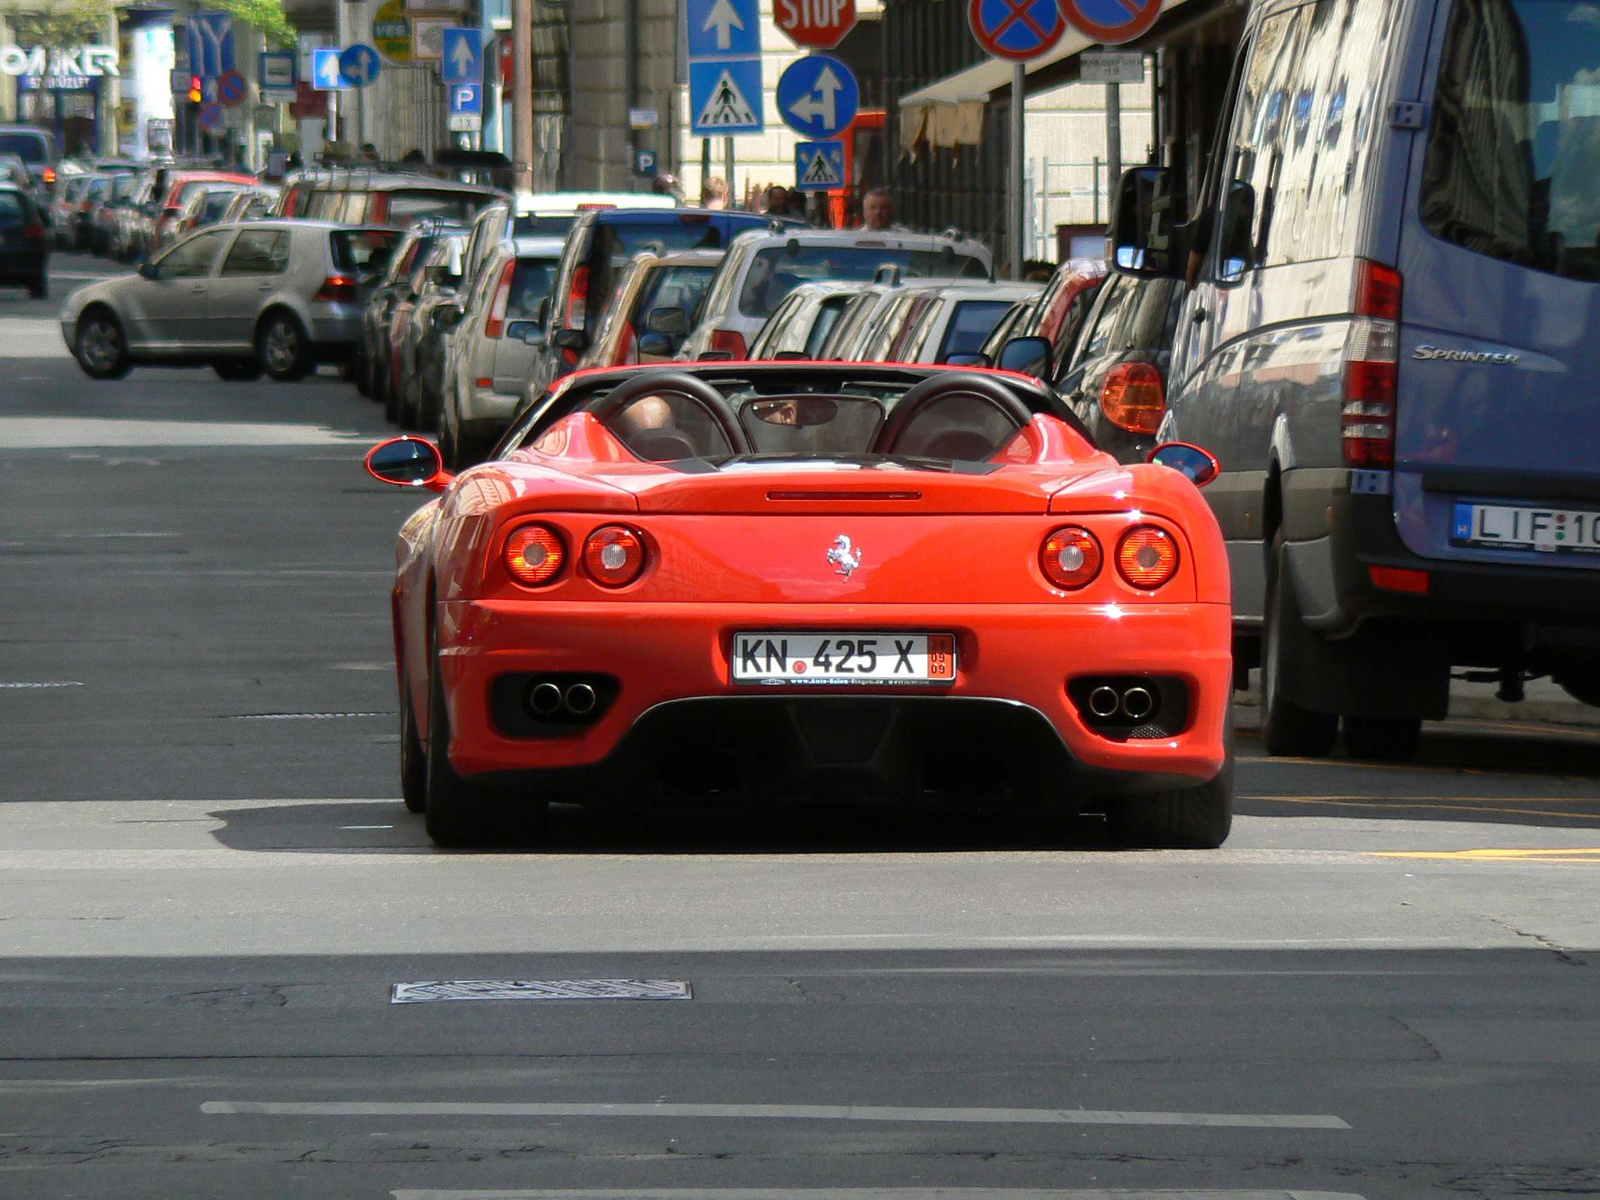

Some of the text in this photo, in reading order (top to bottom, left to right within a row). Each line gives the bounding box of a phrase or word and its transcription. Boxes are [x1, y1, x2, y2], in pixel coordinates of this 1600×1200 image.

[781, 0, 848, 29] STOP
[457, 88, 474, 111] P
[639, 154, 654, 172] P
[1411, 344, 1519, 365] SPRINTER
[741, 639, 915, 674] KN 425 X
[931, 664, 945, 674] 09
